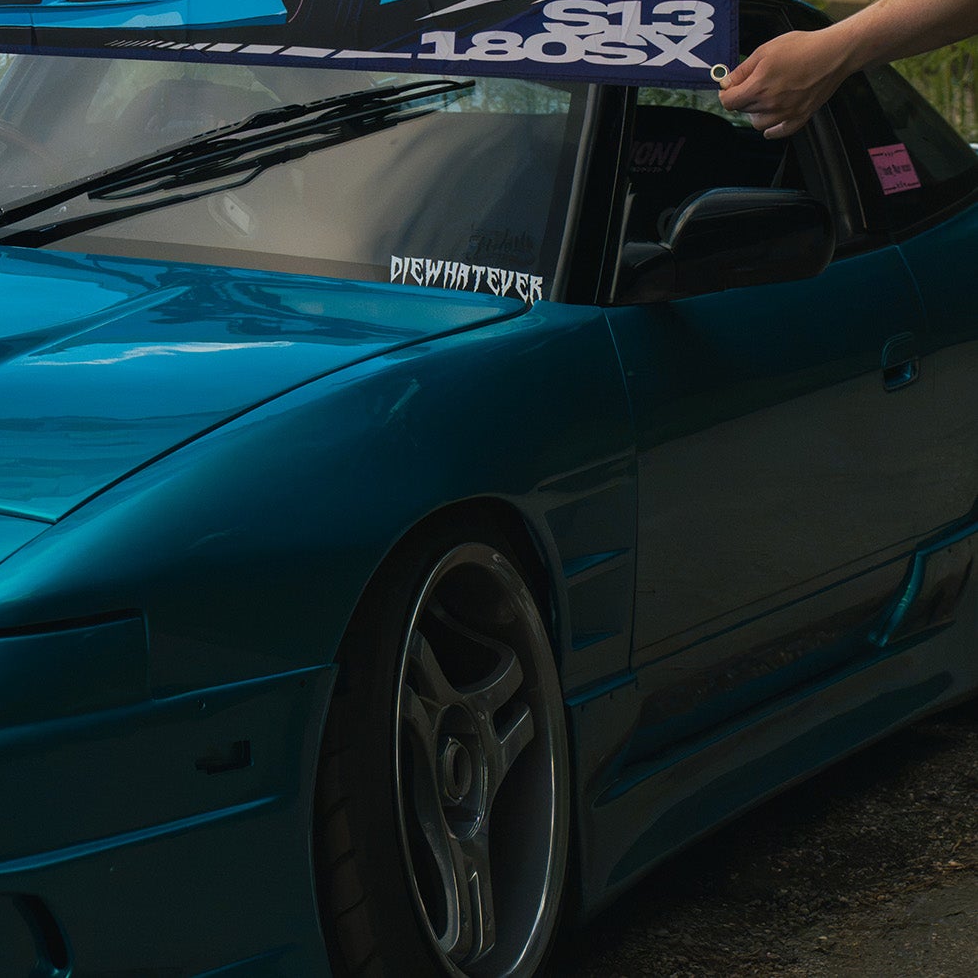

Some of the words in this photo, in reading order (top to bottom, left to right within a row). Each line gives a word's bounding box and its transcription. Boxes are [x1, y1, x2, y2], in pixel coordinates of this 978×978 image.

[543, 0, 715, 38] S13
[418, 30, 714, 69] 180SX
[389, 255, 543, 304] DIEWHATEVER
